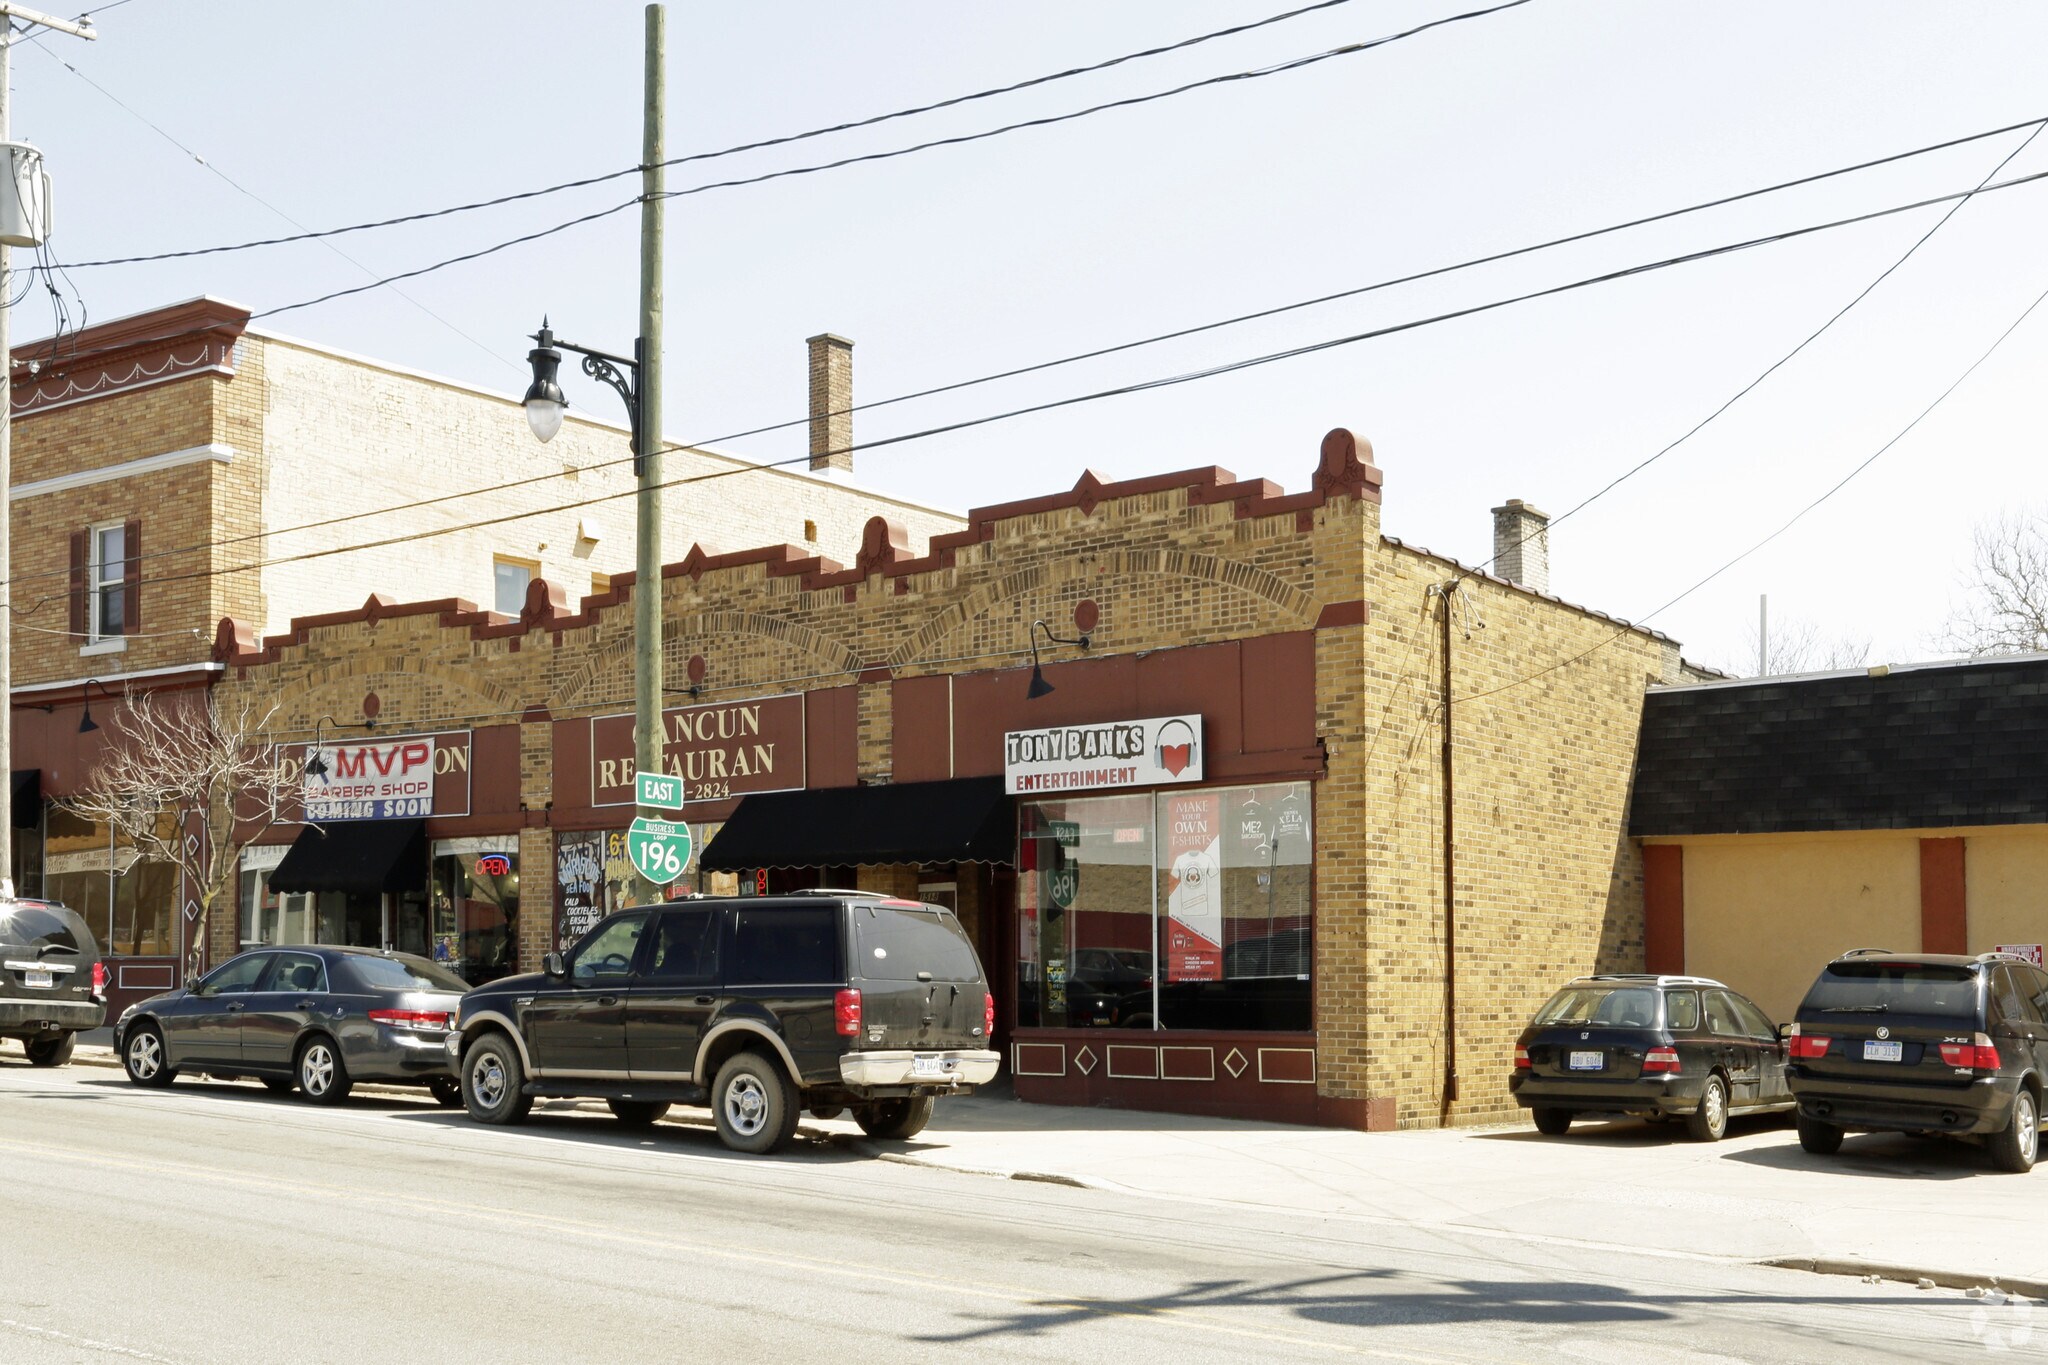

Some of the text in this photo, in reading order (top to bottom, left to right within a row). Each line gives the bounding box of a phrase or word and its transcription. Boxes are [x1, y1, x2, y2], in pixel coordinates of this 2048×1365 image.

[1008, 727, 1144, 762] TONY BANKS
[336, 743, 429, 779] MVP
[1016, 767, 1137, 791] ENTERTAINMENT
[307, 782, 428, 799] BARBER SHOP
[645, 780, 674, 801] EAST
[307, 798, 433, 819] COMING SOON
[1176, 800, 1208, 813] MAKE
[645, 822, 676, 834] BUSINESS
[1174, 820, 1207, 834] OWN
[1241, 820, 1261, 833] ME?
[1116, 829, 1140, 841] OPEN
[1171, 834, 1212, 846] T-SHIRTS
[640, 841, 680, 874] 196
[475, 859, 508, 875] OPEN
[566, 881, 578, 894] SEA
